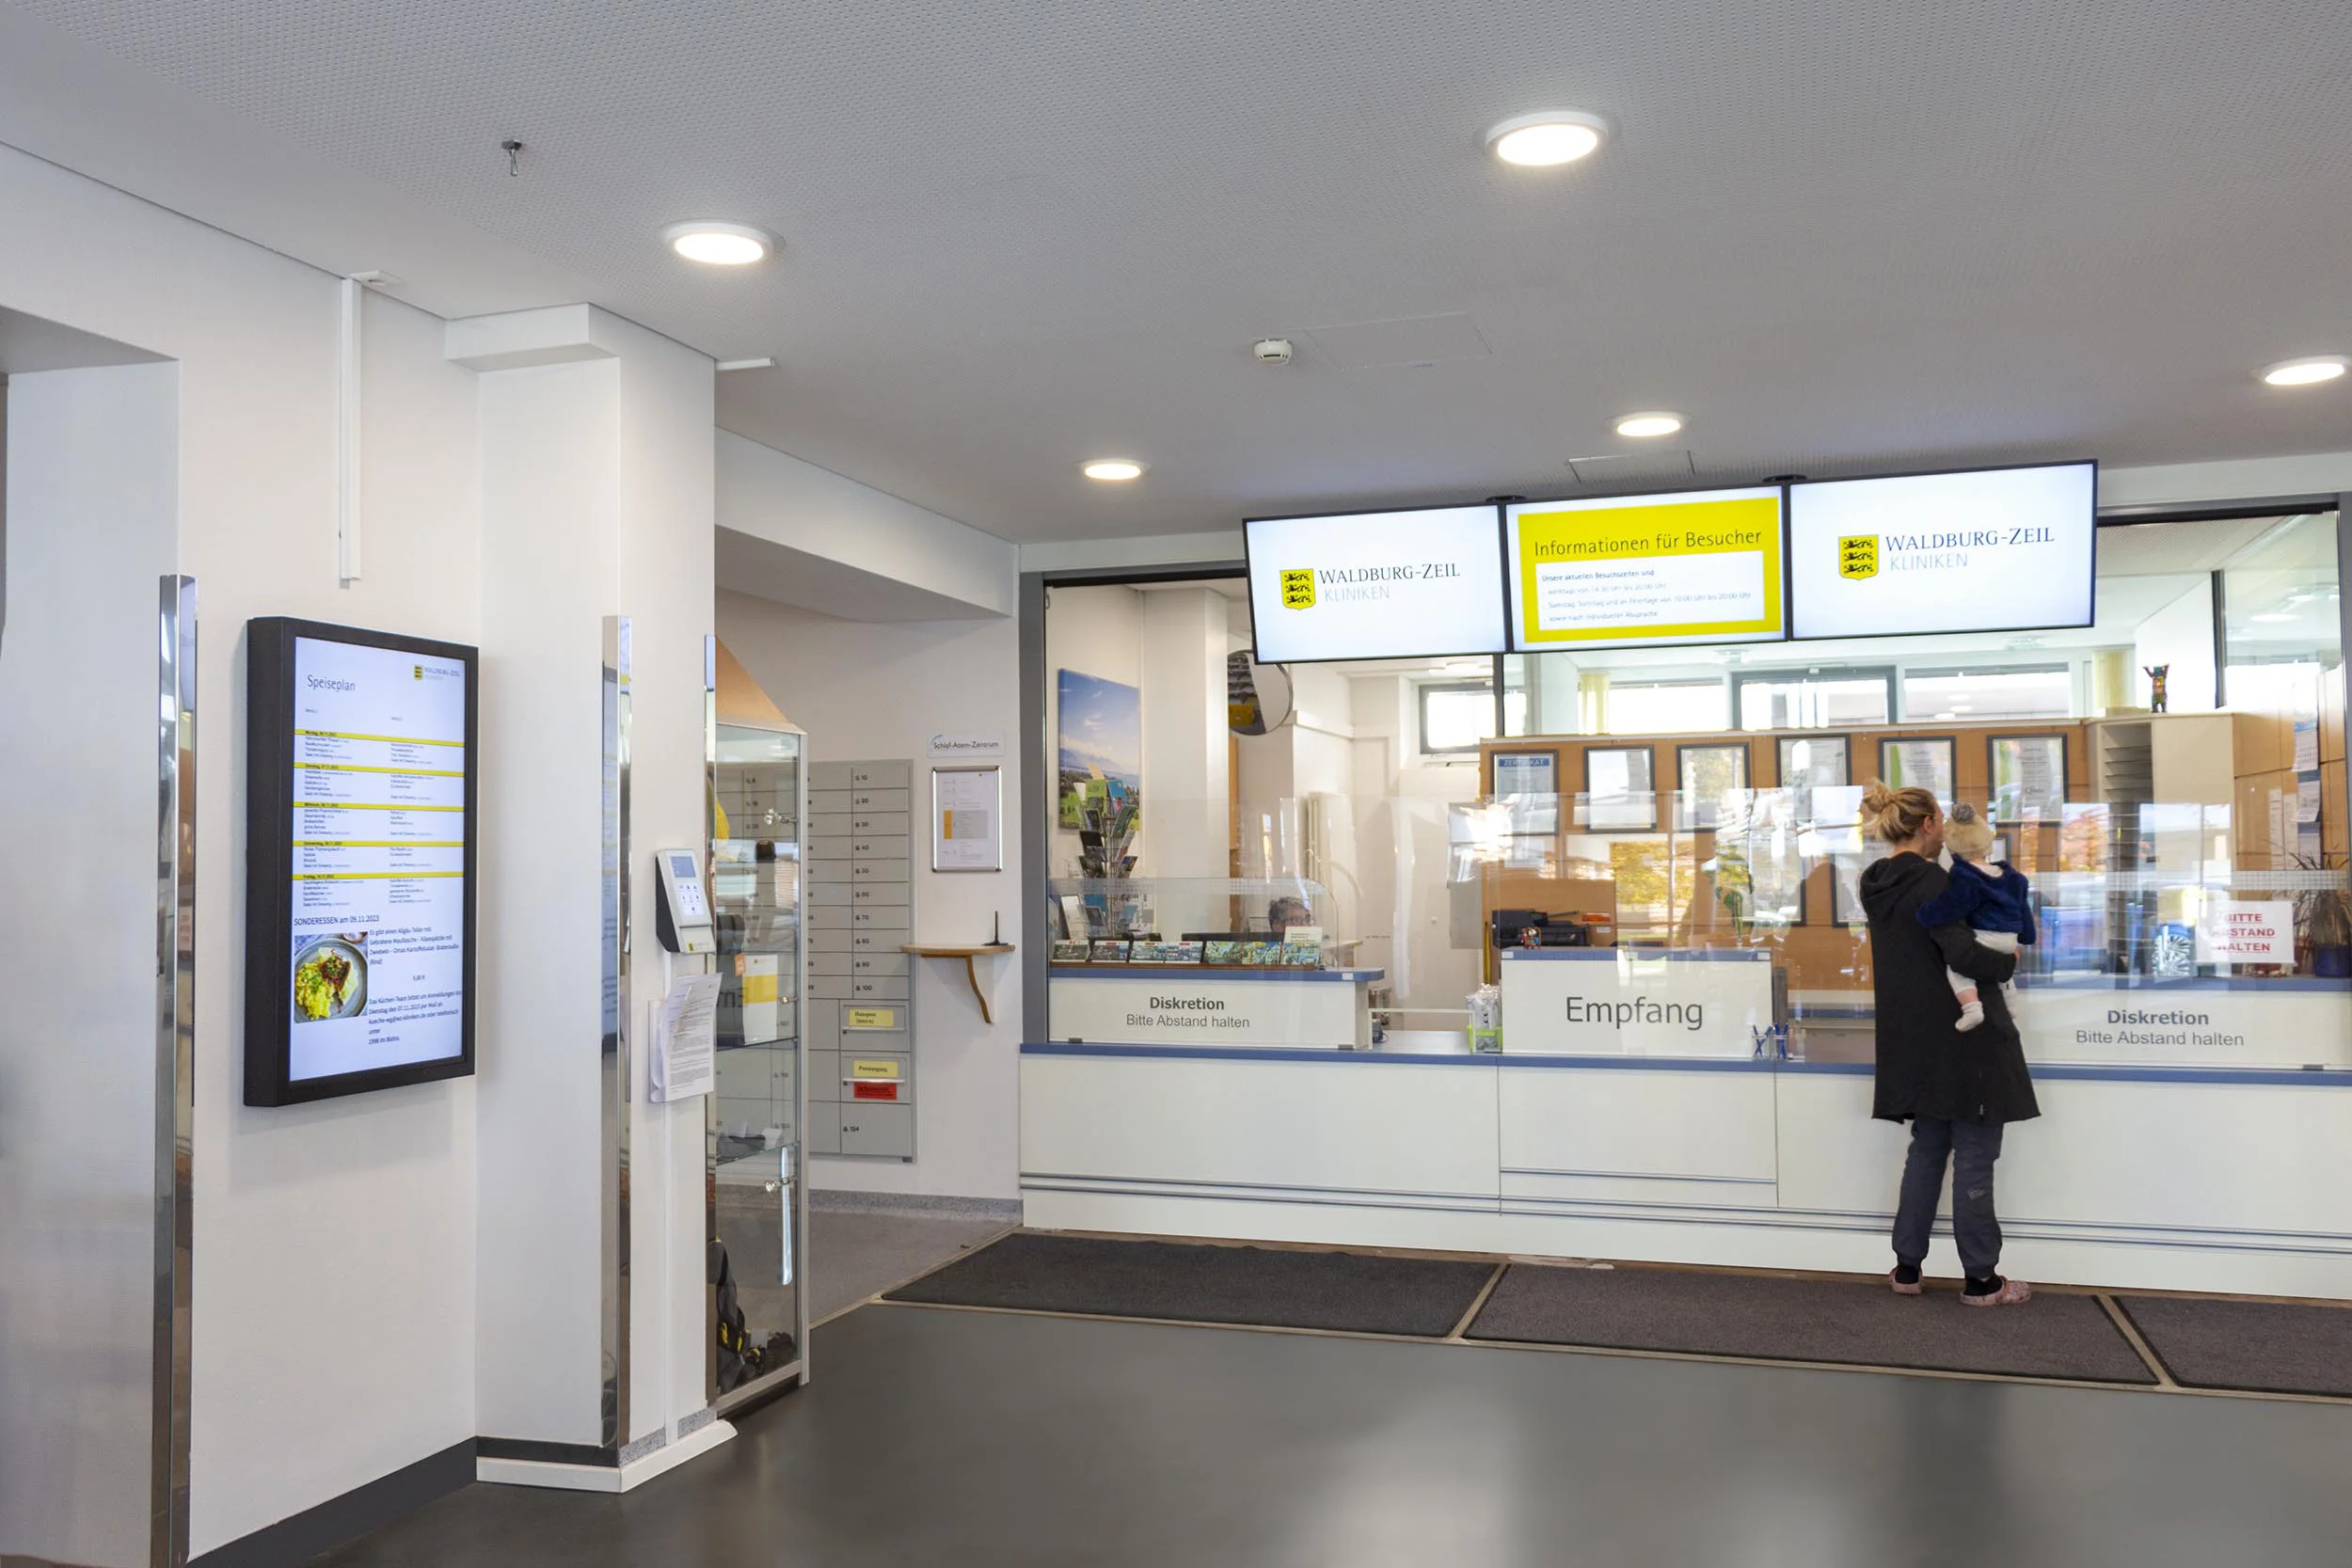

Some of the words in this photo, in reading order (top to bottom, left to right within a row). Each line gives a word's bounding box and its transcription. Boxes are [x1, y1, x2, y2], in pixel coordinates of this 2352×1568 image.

[1534, 536, 1649, 556] Informationen
[1656, 533, 1679, 549] für
[1686, 529, 1761, 546] Besucher
[1885, 527, 2055, 552] WALDBURG-ZEIL
[1889, 552, 1968, 572] KLINIKEN
[1319, 562, 1460, 584] WALDBURG-ZEIL
[1542, 574, 1563, 582] Unsere
[1565, 572, 1594, 580] aktuellen
[1595, 570, 1639, 579] Besuchszeiten
[1324, 585, 1390, 603] KLINIKEN
[307, 674, 356, 692] Speiseplan
[294, 916, 338, 926] SONDERESSEN
[2213, 927, 2276, 937] STAND
[1150, 996, 1225, 1010] Diskretion
[1126, 1014, 1153, 1025] Bitte
[1156, 1014, 1207, 1027] Abstand
[1212, 1016, 1250, 1028] halten
[1566, 996, 1703, 1031] Empfang
[2107, 1009, 2209, 1025] Diskretion
[2076, 1030, 2113, 1044] Bitte
[2117, 1031, 2186, 1045] Abstand
[2192, 1032, 2245, 1046] halten
